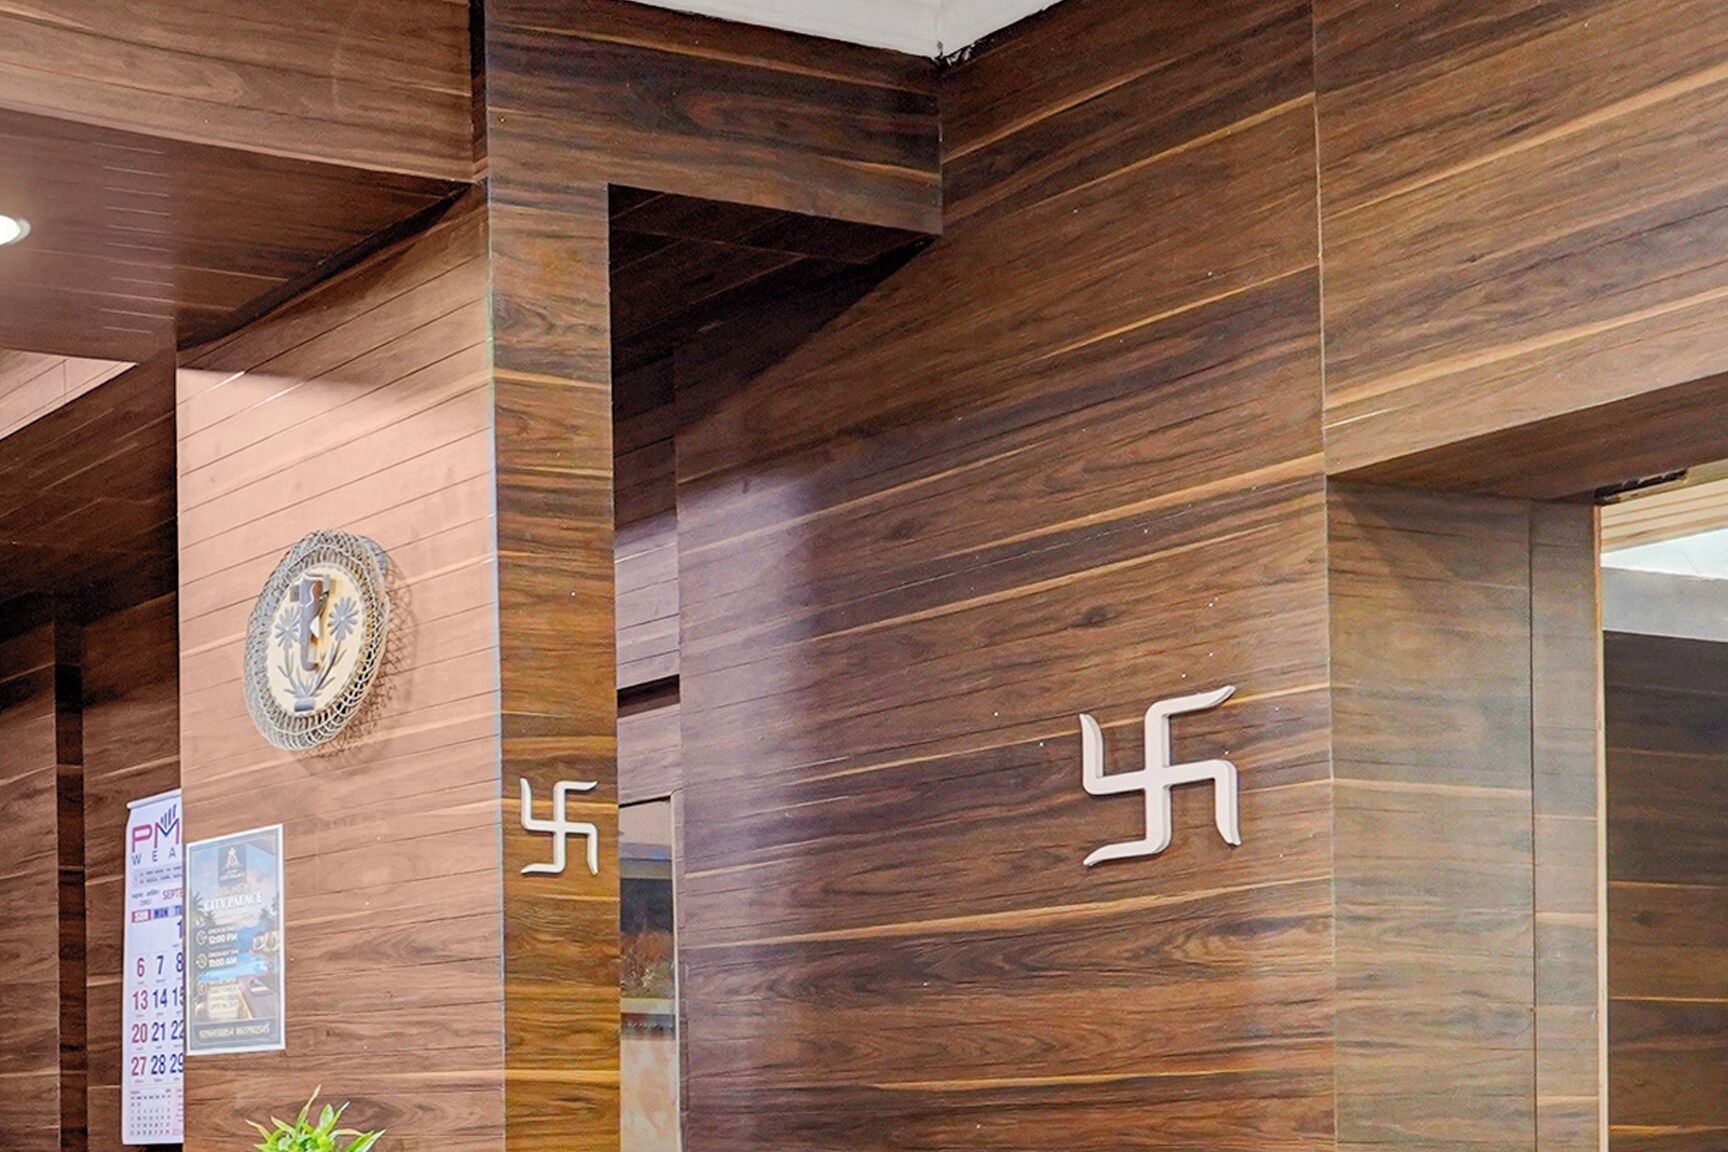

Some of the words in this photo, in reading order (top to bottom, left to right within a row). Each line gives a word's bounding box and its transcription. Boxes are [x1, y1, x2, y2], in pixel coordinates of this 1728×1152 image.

[137, 956, 145, 977] 6
[156, 954, 164, 975] 7
[176, 952, 183, 972] 8
[132, 989, 149, 1010] 13
[152, 988, 168, 1008] 14
[132, 1023, 149, 1043] 20
[151, 1021, 166, 1041] 21
[170, 1019, 184, 1040] 22
[131, 1056, 147, 1076] 27
[151, 1054, 166, 1075] 28
[169, 1052, 184, 1073] 29
